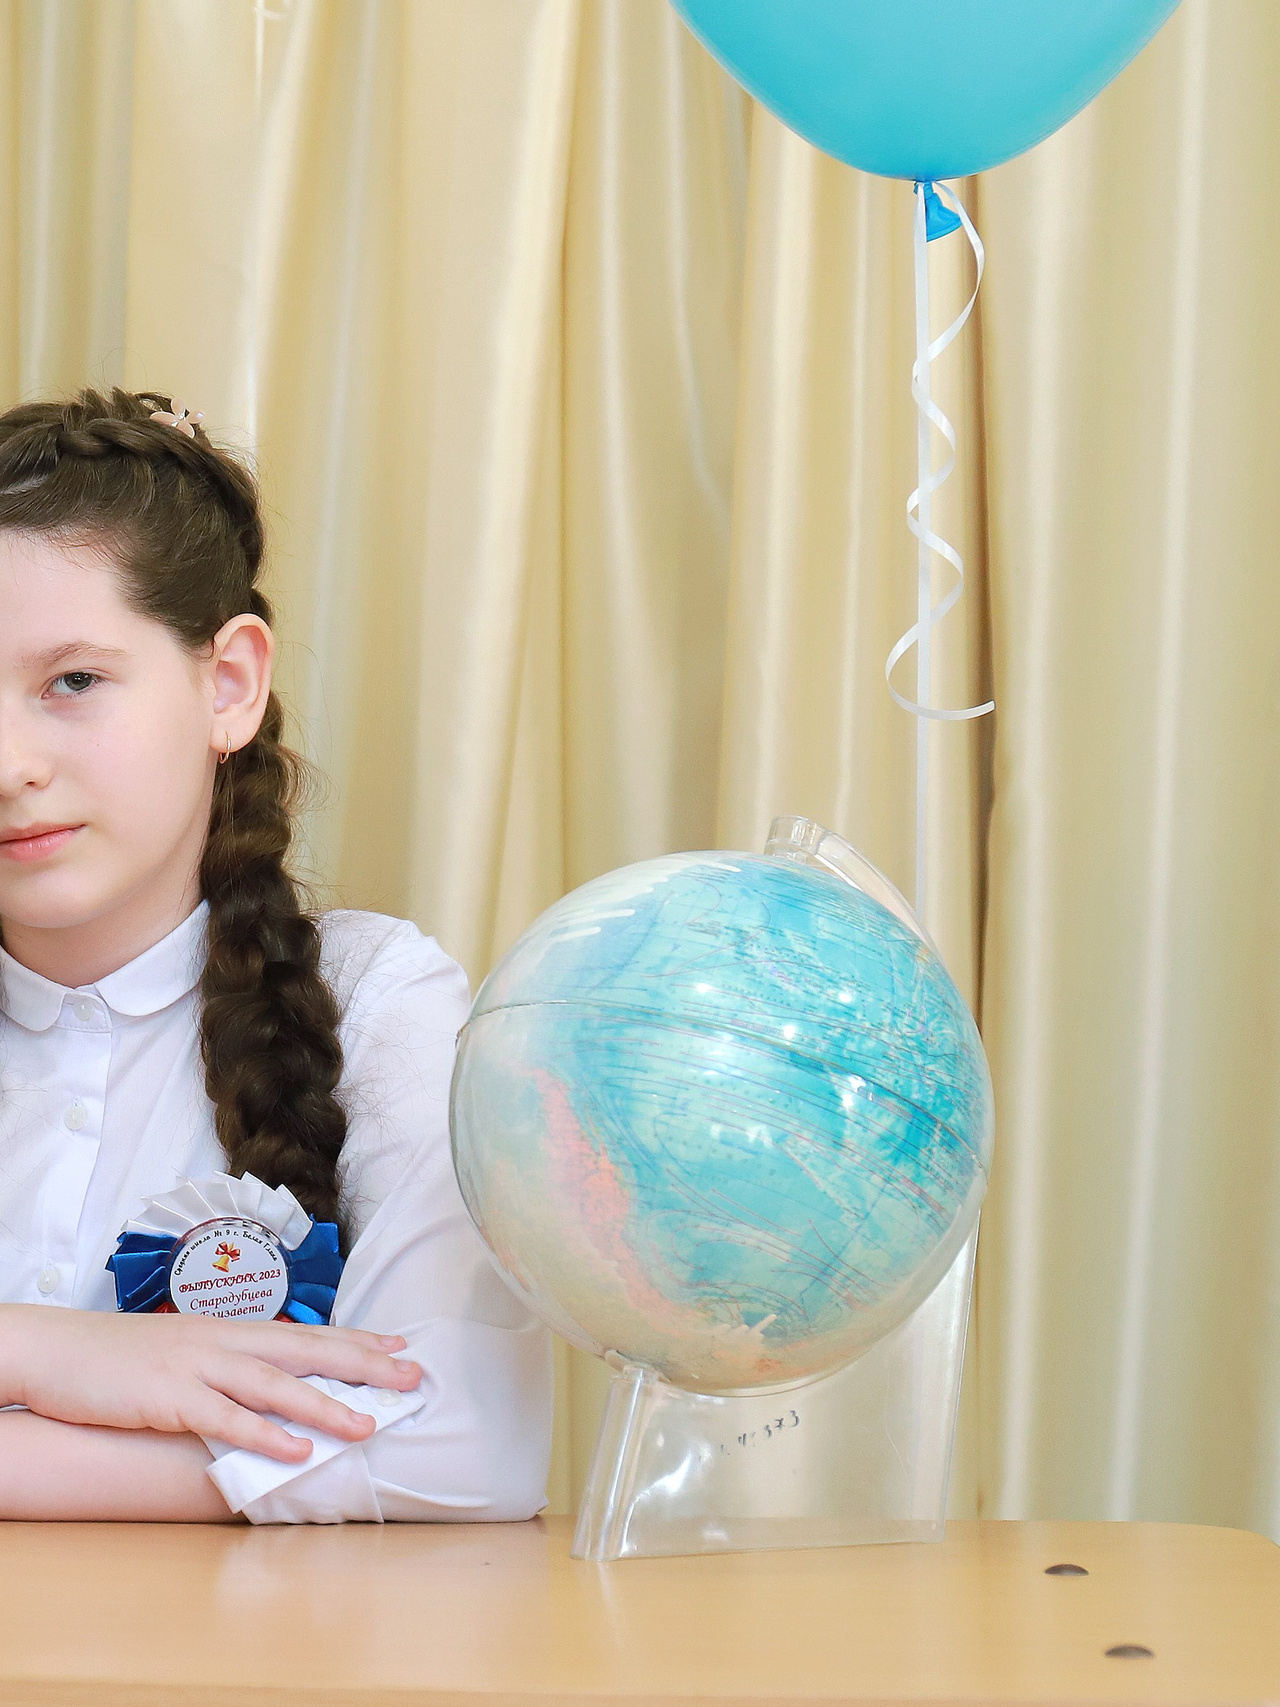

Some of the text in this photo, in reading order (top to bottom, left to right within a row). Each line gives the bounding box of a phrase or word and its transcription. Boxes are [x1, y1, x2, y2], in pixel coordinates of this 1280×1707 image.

[190, 1235, 211, 1251] школа
[243, 1231, 263, 1245] Белая
[179, 1269, 281, 1293] ВЫПУСКНИК 2023
[190, 1289, 273, 1311] Стародубцева
[200, 1304, 265, 1318] изавета
